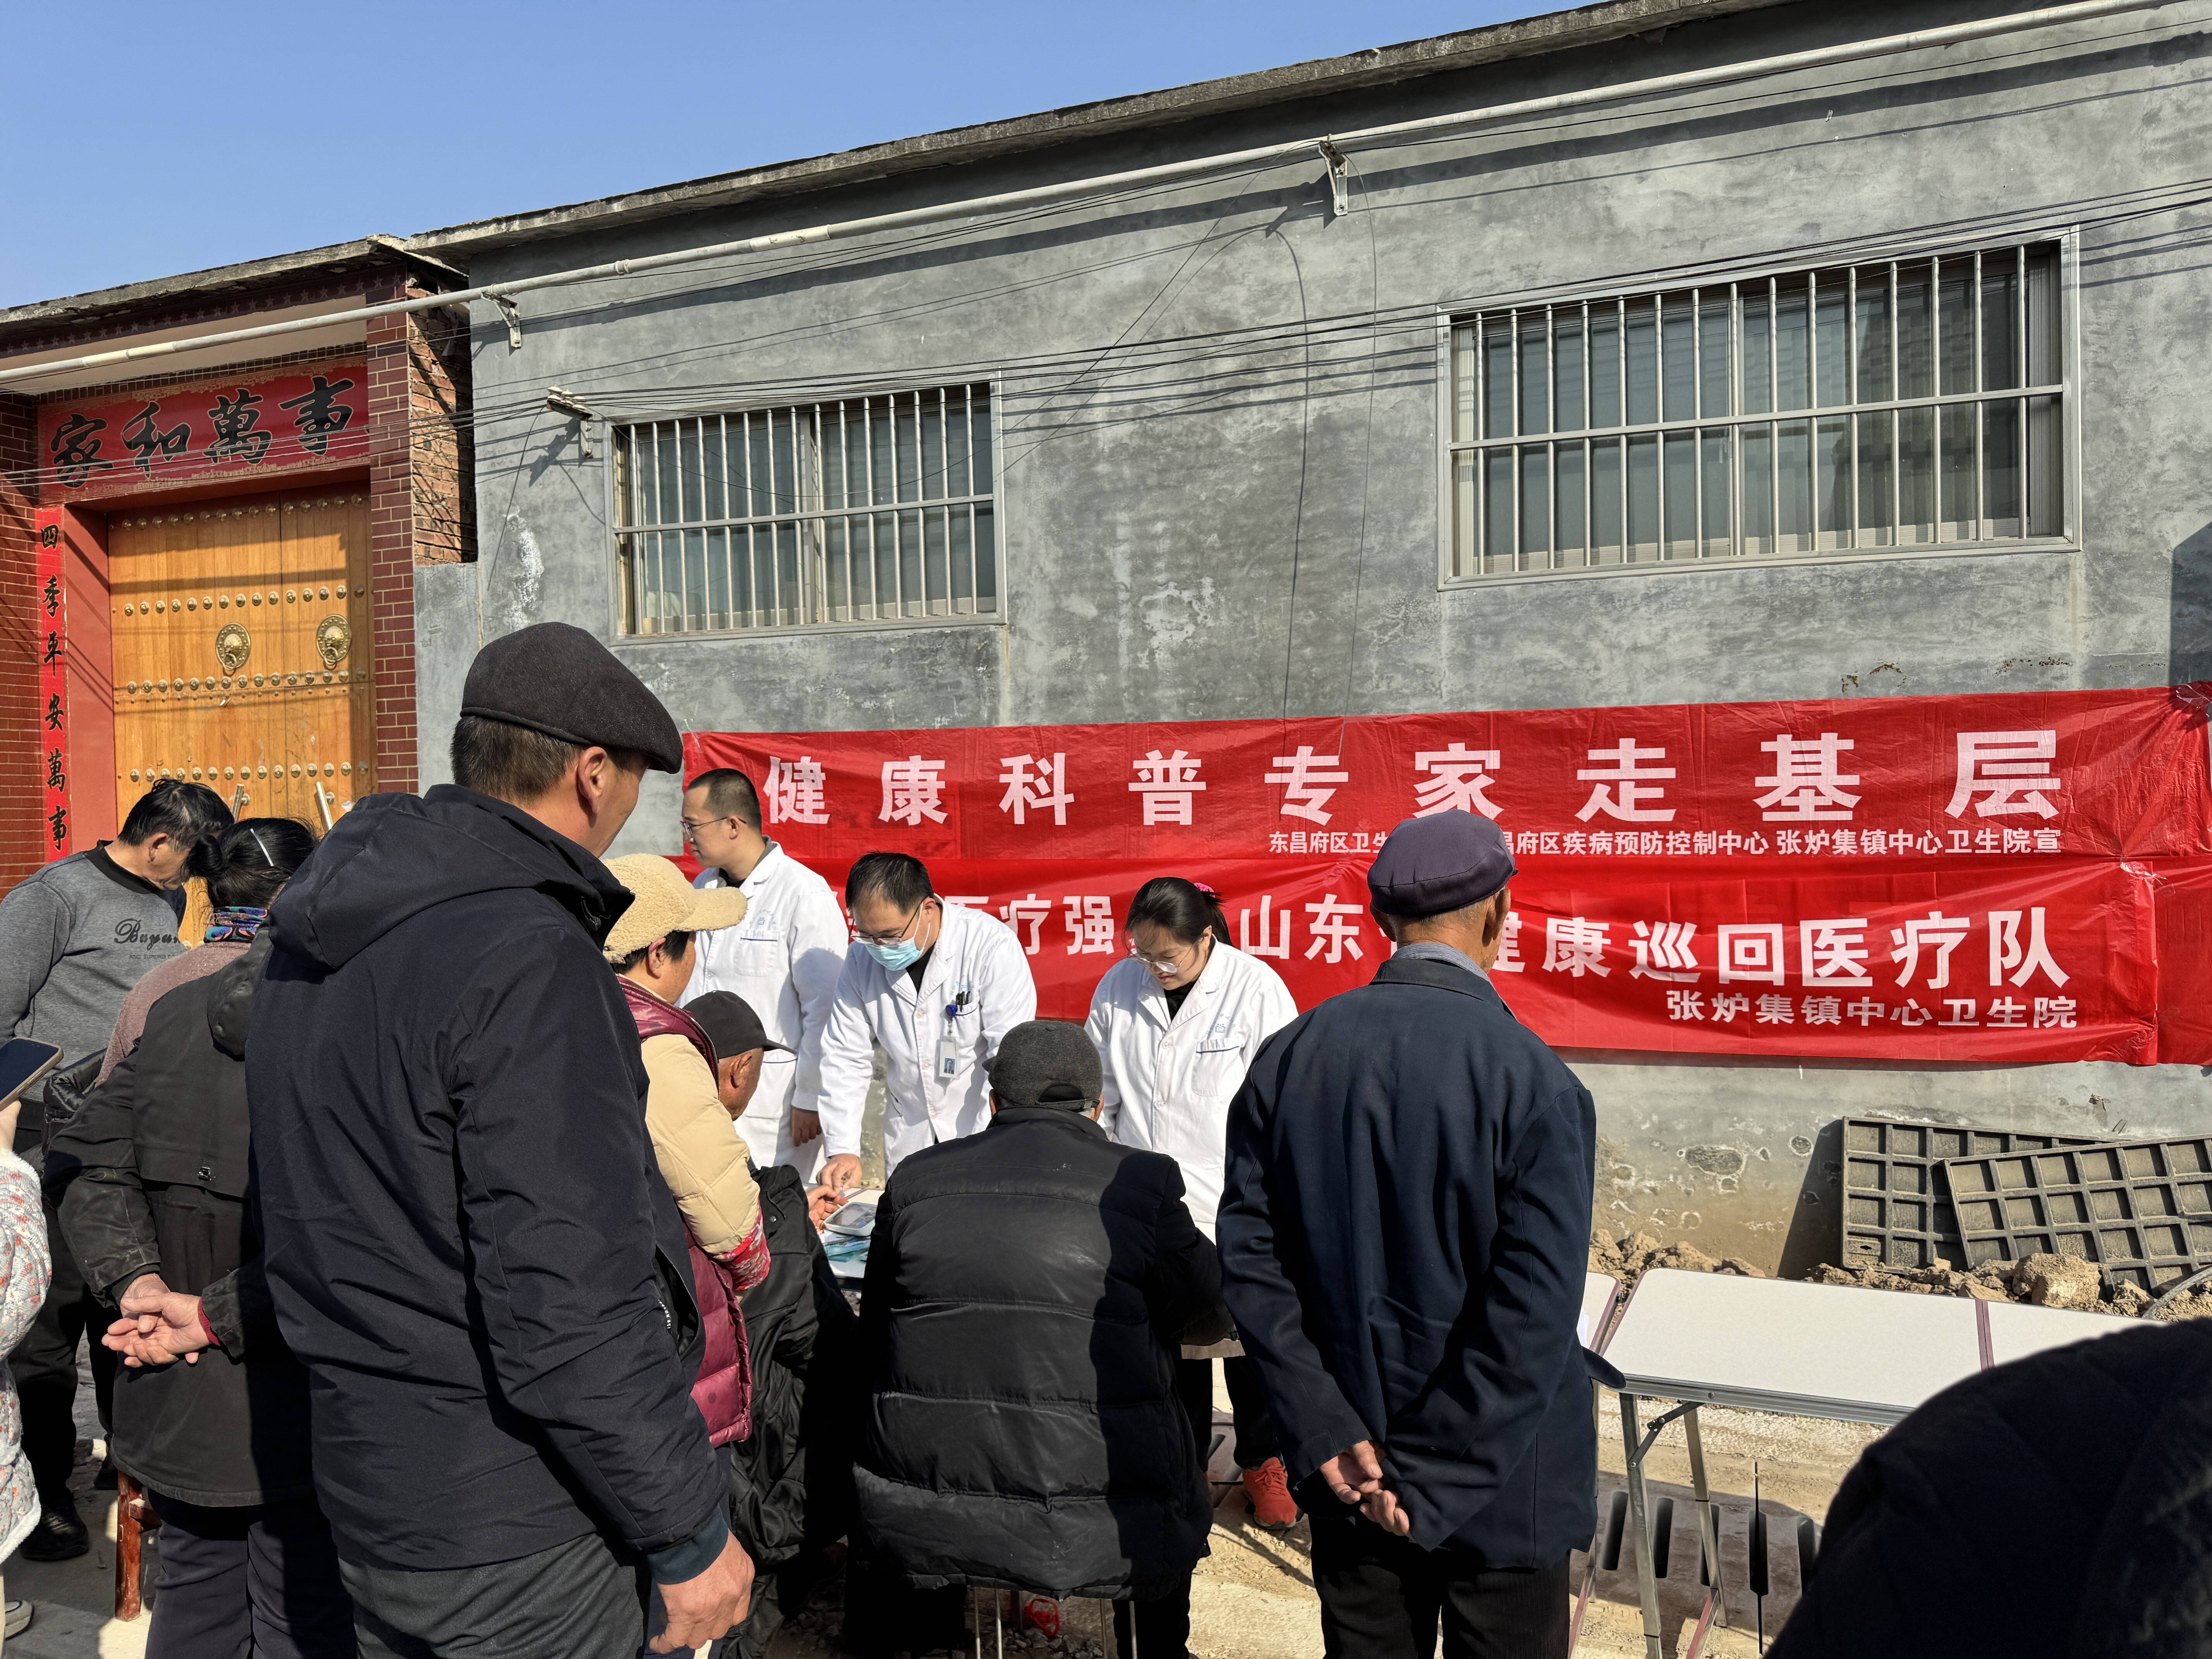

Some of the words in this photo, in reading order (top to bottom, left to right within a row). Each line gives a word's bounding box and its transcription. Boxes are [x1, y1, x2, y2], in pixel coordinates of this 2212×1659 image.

[50, 376, 370, 489] 家和萬事
[762, 730, 2061, 824] 健康科普专家走基层
[1776, 828, 2061, 855] 张炉集镇中心卫生院宣
[1666, 990, 2077, 1028] 张炉集镇中心卫生院
